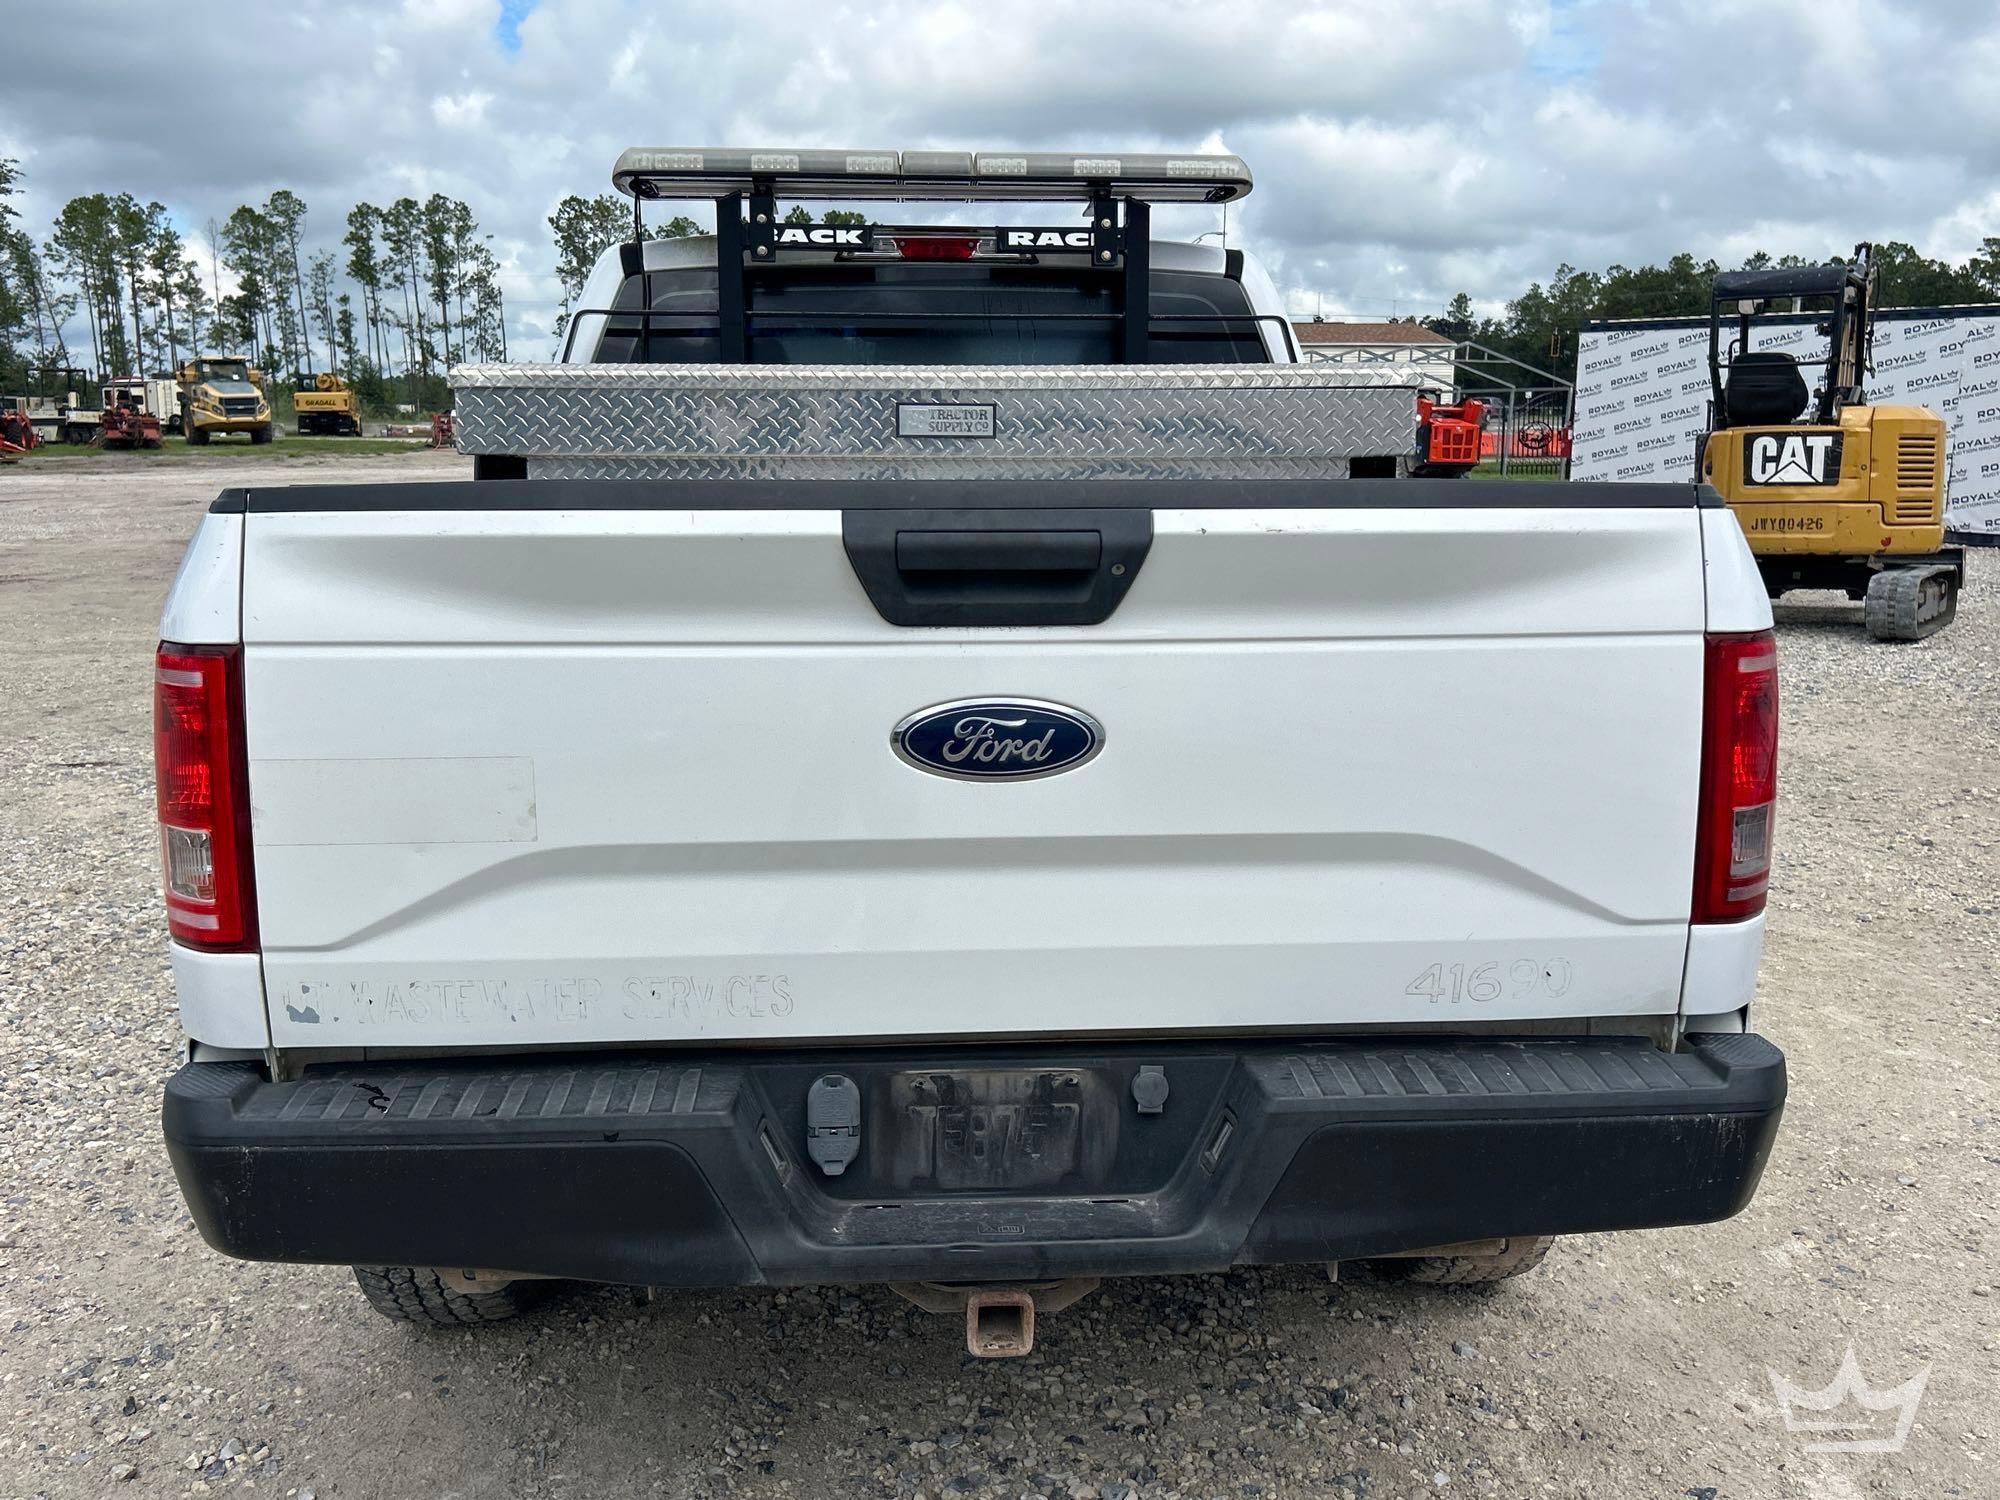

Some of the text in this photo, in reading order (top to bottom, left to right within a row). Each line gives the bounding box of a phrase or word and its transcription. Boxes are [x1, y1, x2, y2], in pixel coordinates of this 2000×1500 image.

[1008, 231, 1095, 246] RAC
[1904, 318, 1944, 335] ROYAL
[1679, 331, 1710, 344] ROYAL
[1758, 333, 1793, 347] ROYAL
[1630, 344, 1660, 358] ROYAL
[1940, 341, 1965, 353] ROY
[1877, 354, 1915, 368] ROYAL
[1974, 351, 2000, 363] ROY
[1585, 358, 1614, 370] ROYAL
[1657, 361, 1688, 374] ROYAL
[1611, 373, 1640, 386] ROYAL
[1907, 373, 1947, 387] ROYAL
[1959, 383, 1986, 394] YAL
[1634, 391, 1664, 403] ROYAL
[928, 409, 988, 420] TRACTOR
[1588, 403, 1617, 414] ROYAL
[1660, 408, 1691, 420] ROYAL
[1977, 407, 2000, 418] ROY
[928, 421, 973, 432] SUPPLY
[1614, 420, 1643, 431] ROYAL
[1573, 430, 1597, 440] OYAL
[1637, 437, 1667, 448] ROYAL
[1591, 448, 1620, 458] ROYAL
[1664, 454, 1694, 465] ROYAL
[1751, 436, 1833, 483] CAT
[1617, 465, 1646, 475] ROYAL
[1952, 492, 1994, 505] ROYAL
[943, 716, 1056, 763] Ford
[1405, 957, 1573, 1004] 41690
[623, 975, 795, 1021] SERVCES
